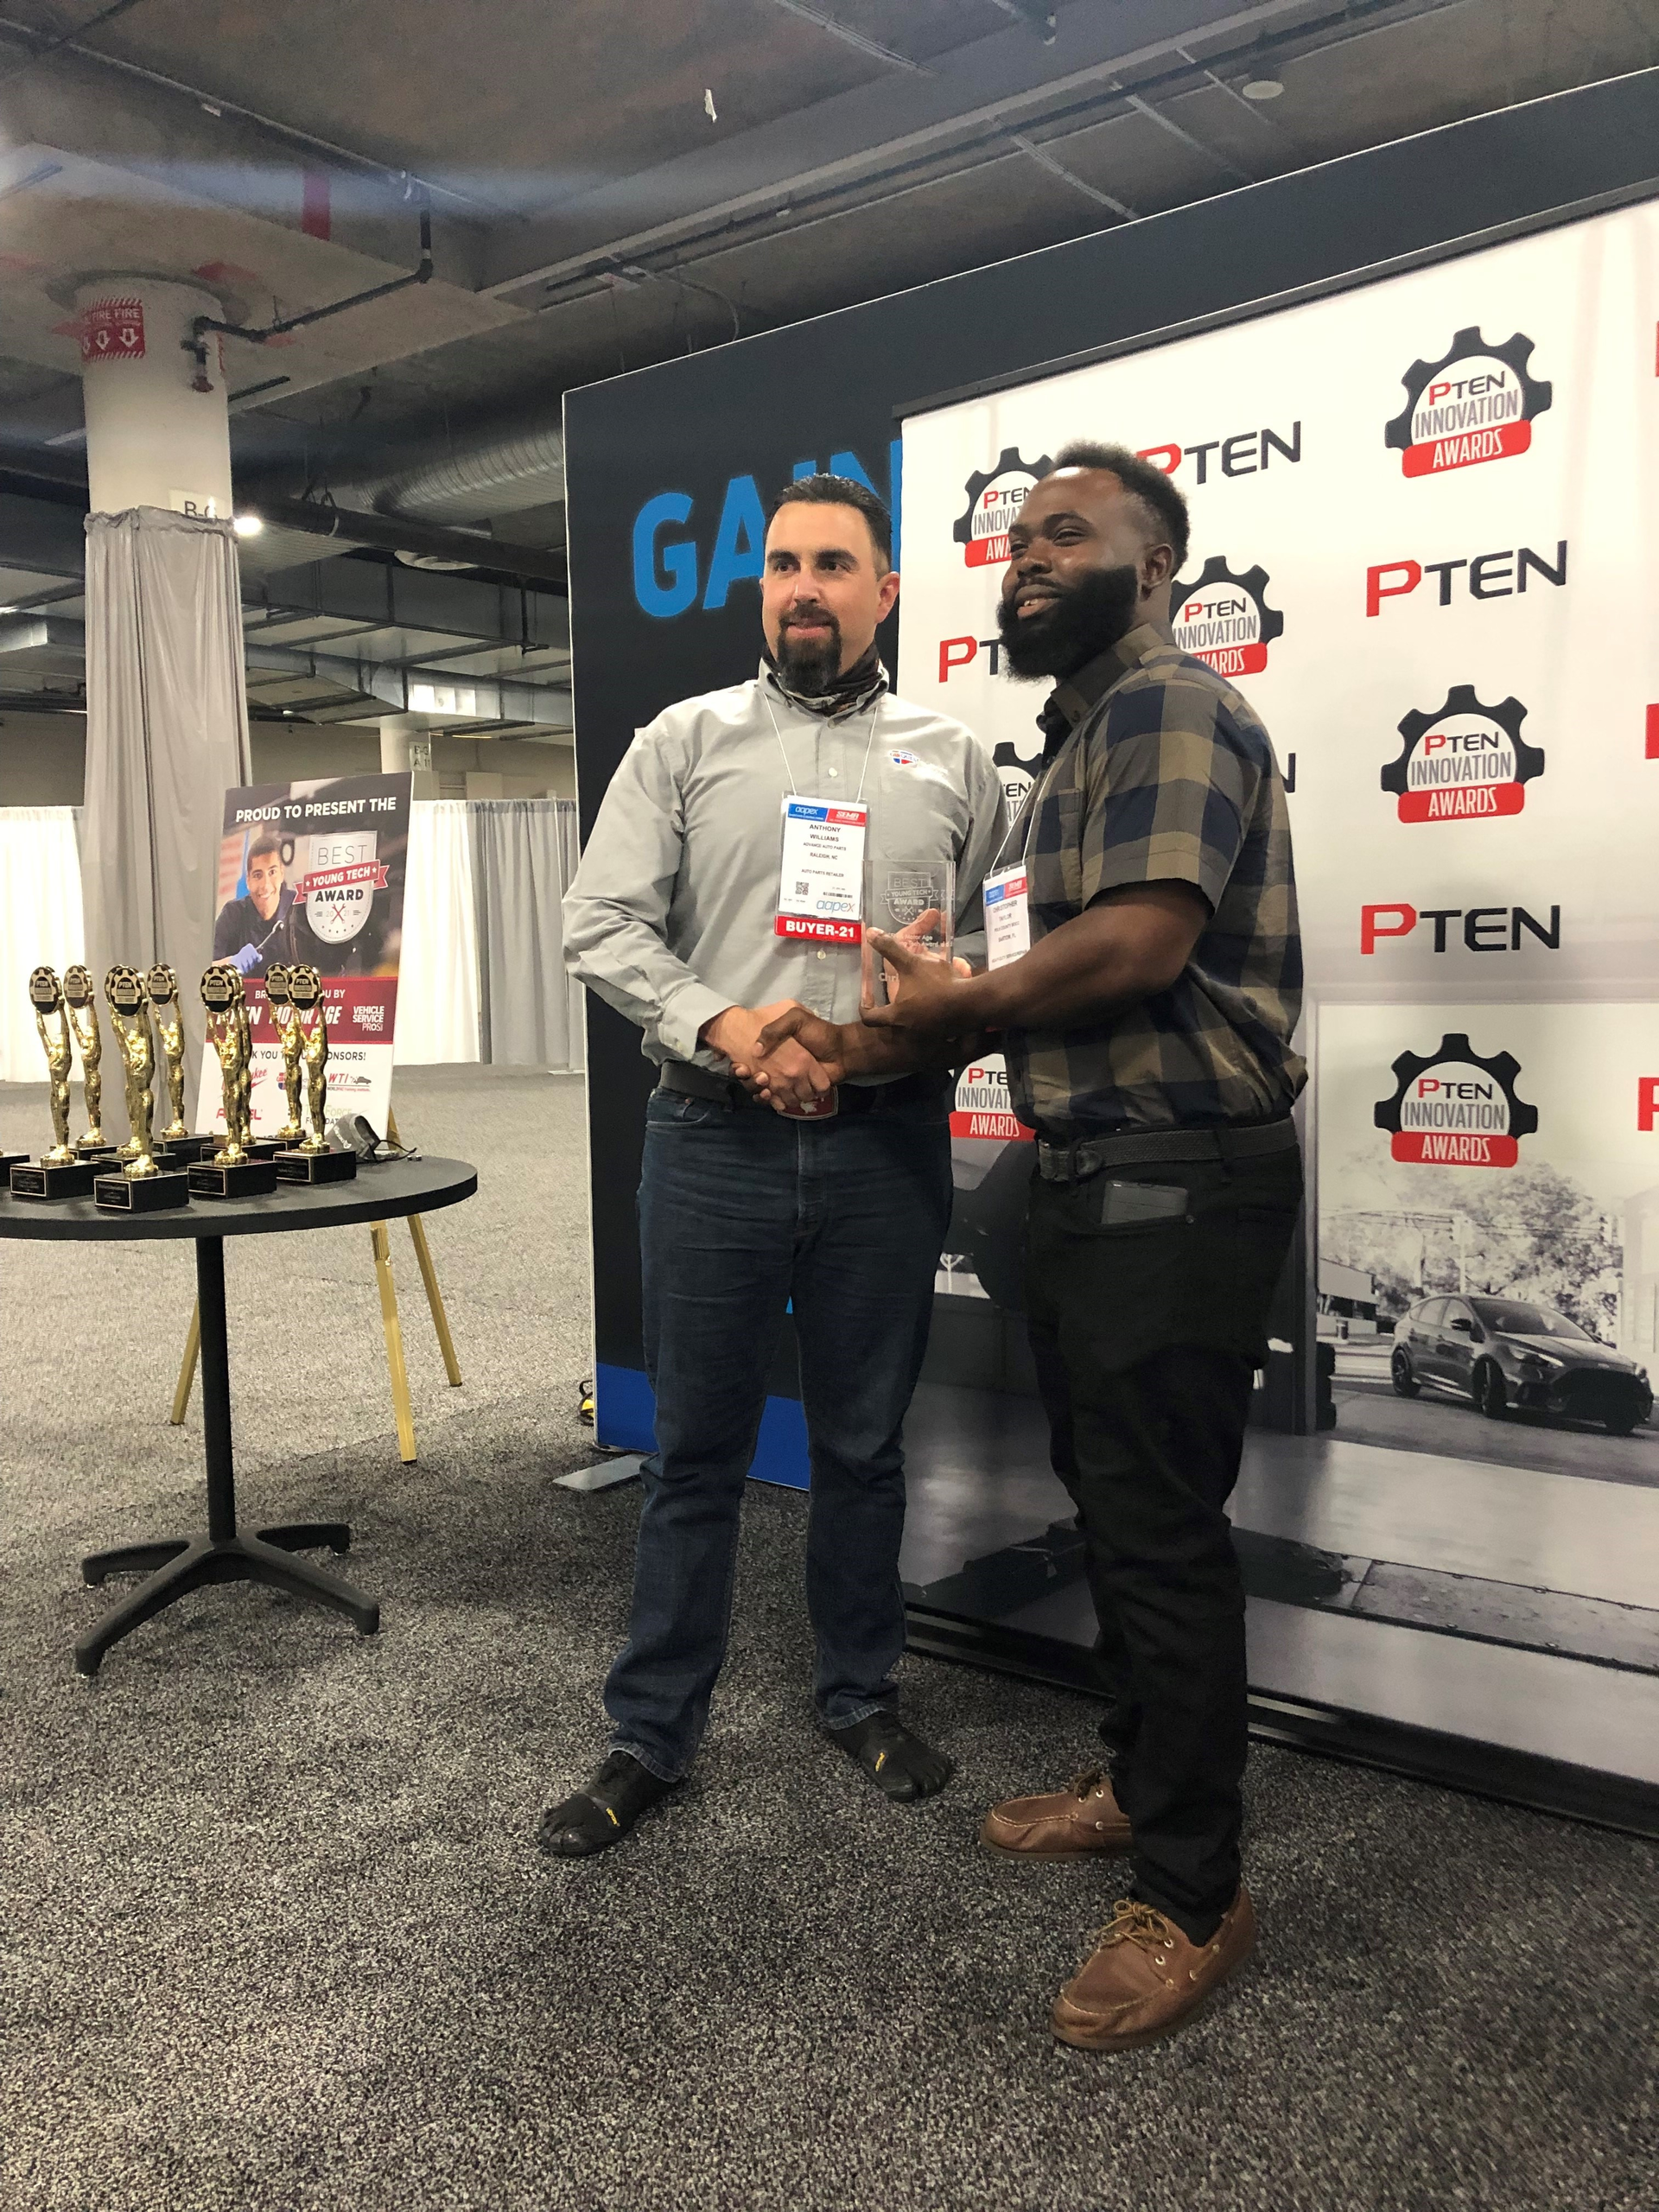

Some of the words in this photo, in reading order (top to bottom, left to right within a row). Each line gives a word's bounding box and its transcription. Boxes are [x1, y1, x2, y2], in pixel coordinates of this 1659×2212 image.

[114, 308, 140, 318] FIRE
[1429, 371, 1505, 405] PTEN
[1414, 389, 1518, 439] INNOVATION
[1433, 428, 1503, 468] AWARDS
[632, 439, 902, 618] GAN
[1366, 540, 1567, 617] PTEN
[1185, 597, 1246, 622] PTEN
[938, 636, 1002, 683] PT
[1196, 648, 1245, 674] ARDS
[1425, 731, 1499, 756] PTEN
[1411, 752, 1511, 785] INNOVATION
[1003, 781, 1031, 798] EN
[235, 807, 281, 823] PROUD
[283, 805, 302, 819] TO
[305, 799, 366, 817] PRESENT
[369, 797, 397, 812] THE
[1427, 787, 1497, 817] AWARDS
[810, 823, 841, 832] ANTHONY
[317, 844, 367, 865] BEST
[312, 871, 344, 887] YOUNG
[346, 866, 371, 880] TECH
[893, 878, 925, 887] BEST
[315, 888, 364, 902] AWARD
[817, 899, 855, 913] aapex
[785, 920, 854, 938] BUYER-21
[1360, 903, 1560, 955] PTEN
[334, 988, 346, 999] BY
[353, 1006, 385, 1014] VEHICLE
[353, 1014, 385, 1023] SERVICE
[260, 1051, 277, 1059] YOU
[327, 1052, 366, 1060] ONSORS!
[328, 1073, 349, 1084] WTI
[968, 1068, 1008, 1085] PTE
[958, 1087, 1011, 1109] INNOVAT
[1418, 1078, 1493, 1100] PTEN
[969, 1114, 1020, 1137] AWARDS
[1404, 1102, 1505, 1130] INNOVATION
[1421, 1135, 1491, 1162] AWARDS
